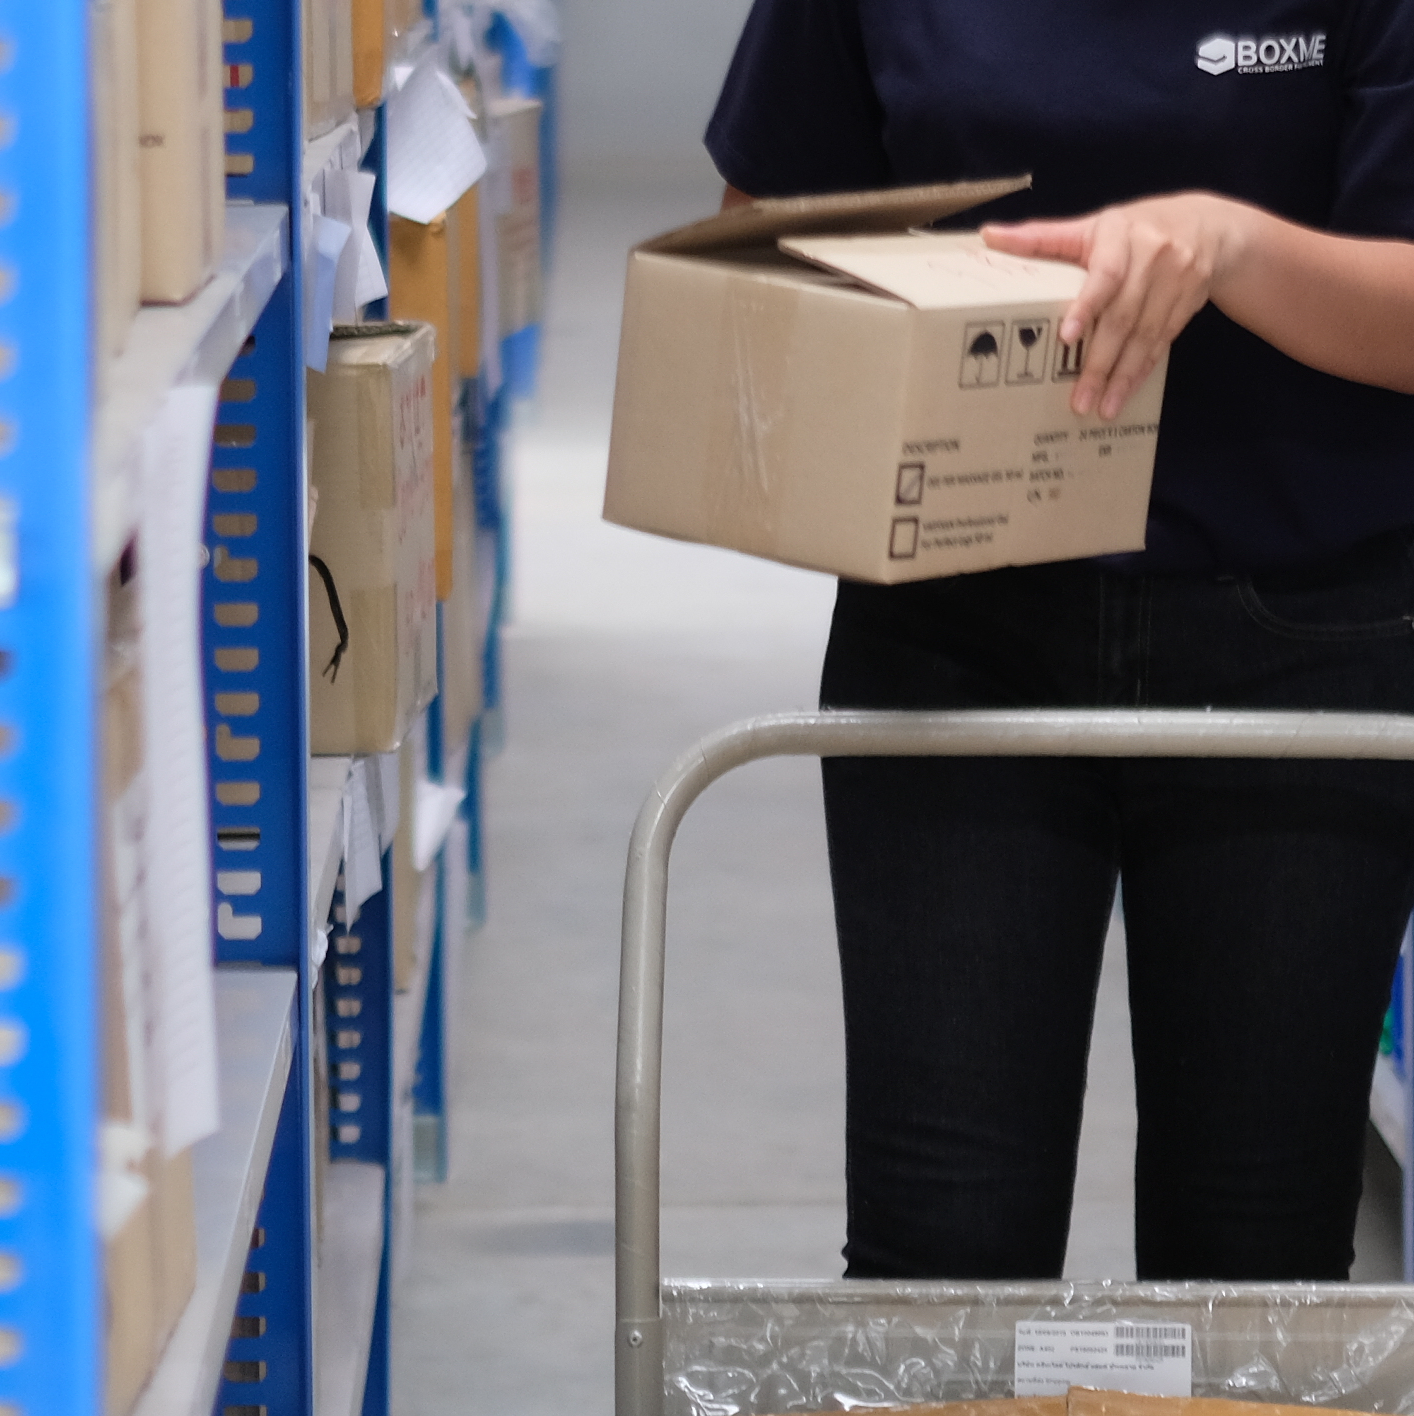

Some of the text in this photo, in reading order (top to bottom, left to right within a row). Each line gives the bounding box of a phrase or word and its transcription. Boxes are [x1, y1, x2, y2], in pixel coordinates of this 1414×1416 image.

[1237, 35, 1327, 67] BOXME
[1238, 65, 1264, 75] CROSS
[1265, 62, 1293, 73] BORDER
